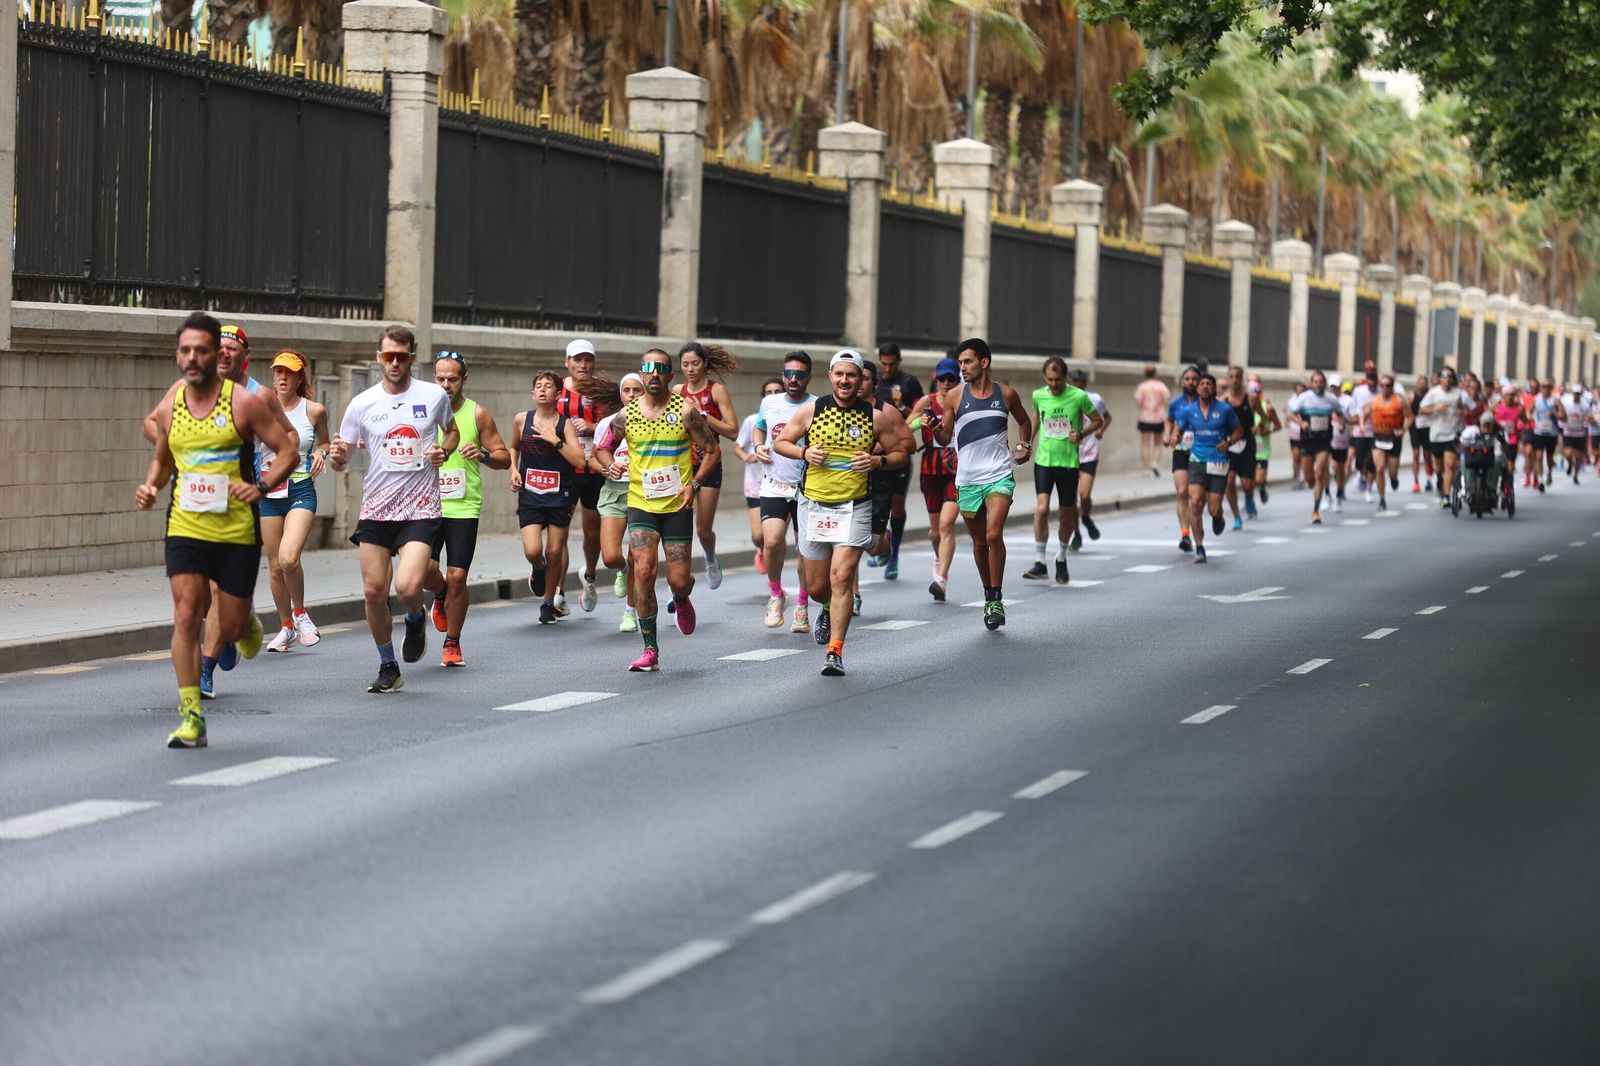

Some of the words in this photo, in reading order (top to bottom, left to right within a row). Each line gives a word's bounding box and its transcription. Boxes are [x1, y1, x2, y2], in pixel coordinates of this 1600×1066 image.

[390, 447, 414, 456] 834
[530, 475, 555, 484] 2513
[651, 474, 672, 484] 891
[190, 483, 215, 494] 906
[817, 520, 839, 529] 243
